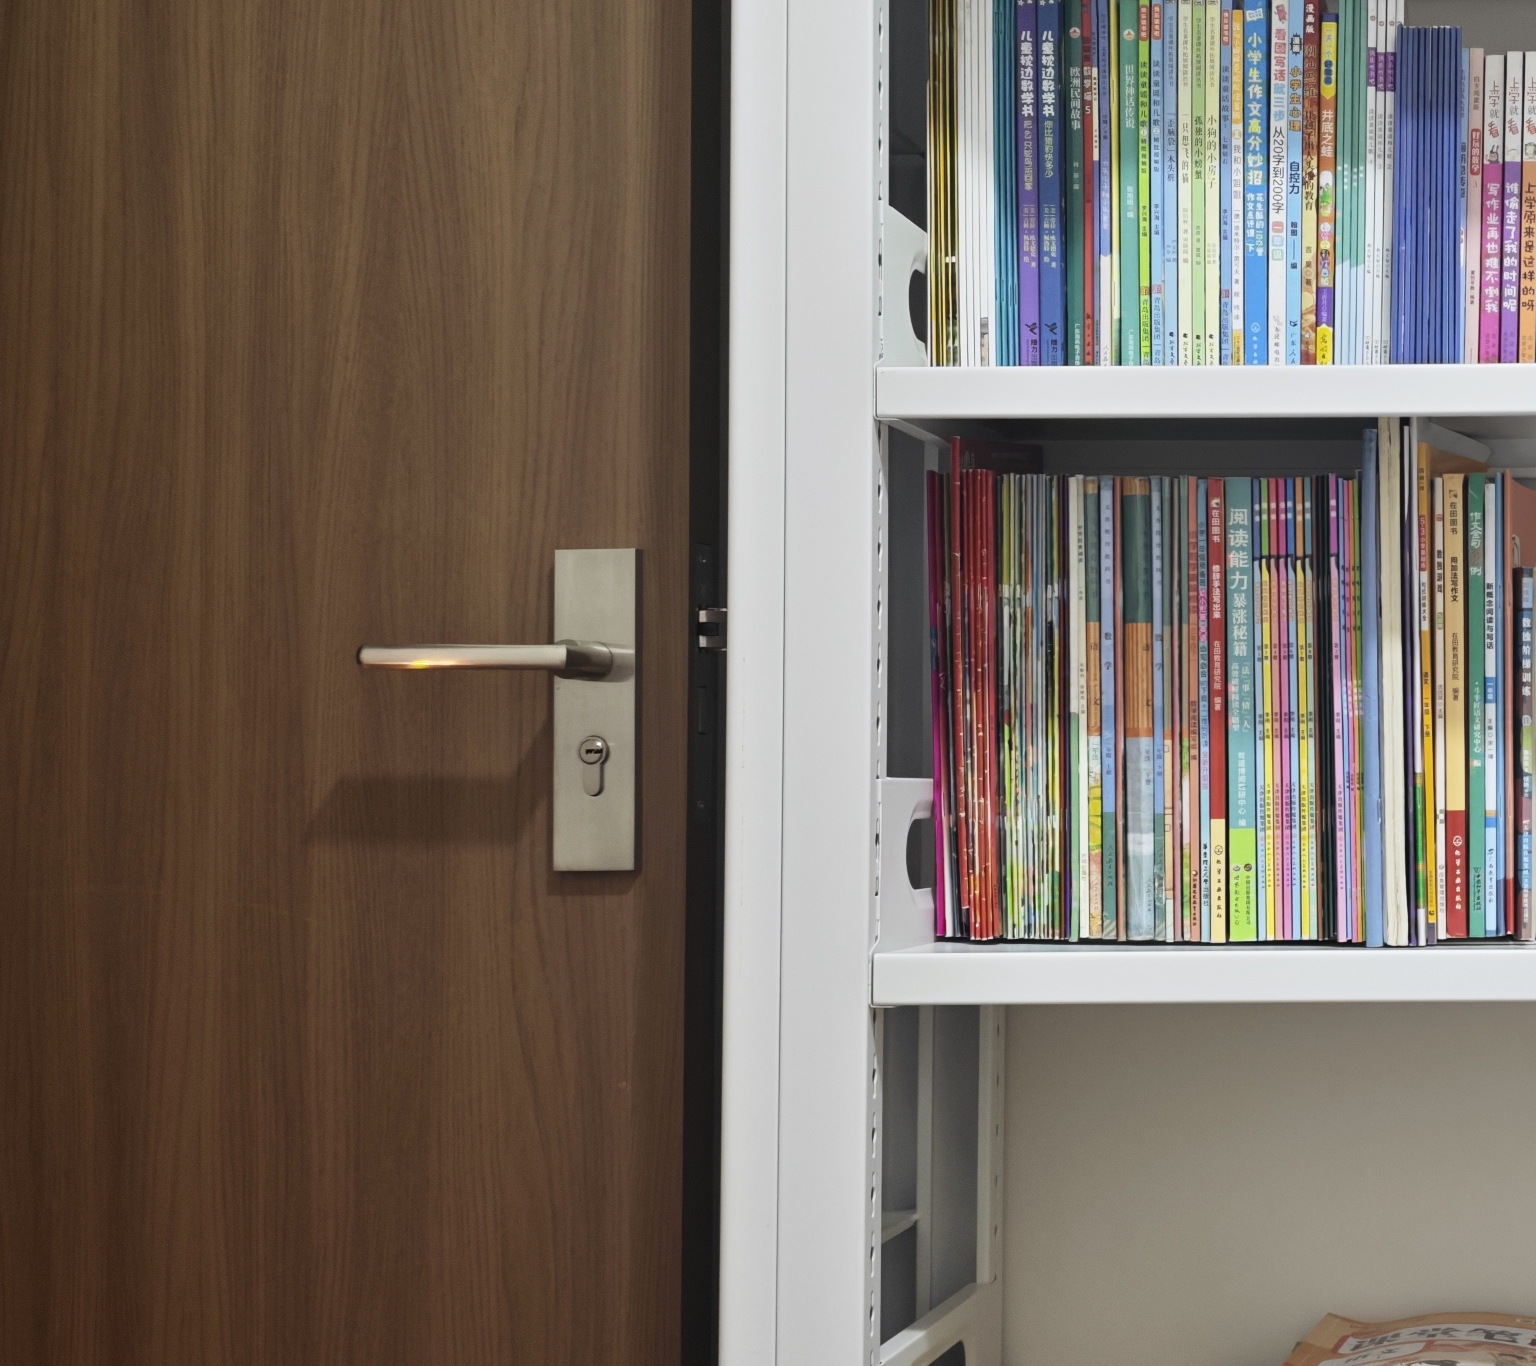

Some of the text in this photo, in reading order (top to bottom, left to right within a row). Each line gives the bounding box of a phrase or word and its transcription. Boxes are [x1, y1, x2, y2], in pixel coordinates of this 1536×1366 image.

[1305, 3, 1315, 34] 漫画版
[1020, 30, 1035, 117] 儿童枕边数学书
[1041, 30, 1055, 117] 儿童枕边数学书
[1069, 66, 1081, 130] 欧洲民间故事
[1125, 64, 1135, 129] 世界神话传说
[1507, 76, 1520, 136] 上学就看
[1247, 32, 1263, 185] 小学生作文高分妙招
[1320, 109, 1334, 158] 井底之蛙
[1487, 80, 1500, 139] 上学就看
[1182, 114, 1190, 184] 一只想飞的猫
[1194, 115, 1203, 180] 孤独的小螃蟹
[1206, 115, 1217, 189] 小狗的小房子
[1289, 160, 1300, 195] 自控力
[1484, 183, 1500, 313] 写作业再也难不倒我
[1503, 182, 1519, 313] 谁偷走了我的时间呢
[1521, 183, 1536, 312] 上学原来是这样的呀
[1229, 507, 1249, 590] 阅读能力
[1450, 501, 1458, 535] 在田图书
[1450, 556, 1459, 602] 用加法写作文
[1232, 592, 1247, 657] 暴涨秘籍
[1486, 582, 1494, 650] 新概念阅读与写话
[1451, 632, 1459, 681] 在田教育研究院
[1522, 616, 1532, 696] 数独阶梯训练
